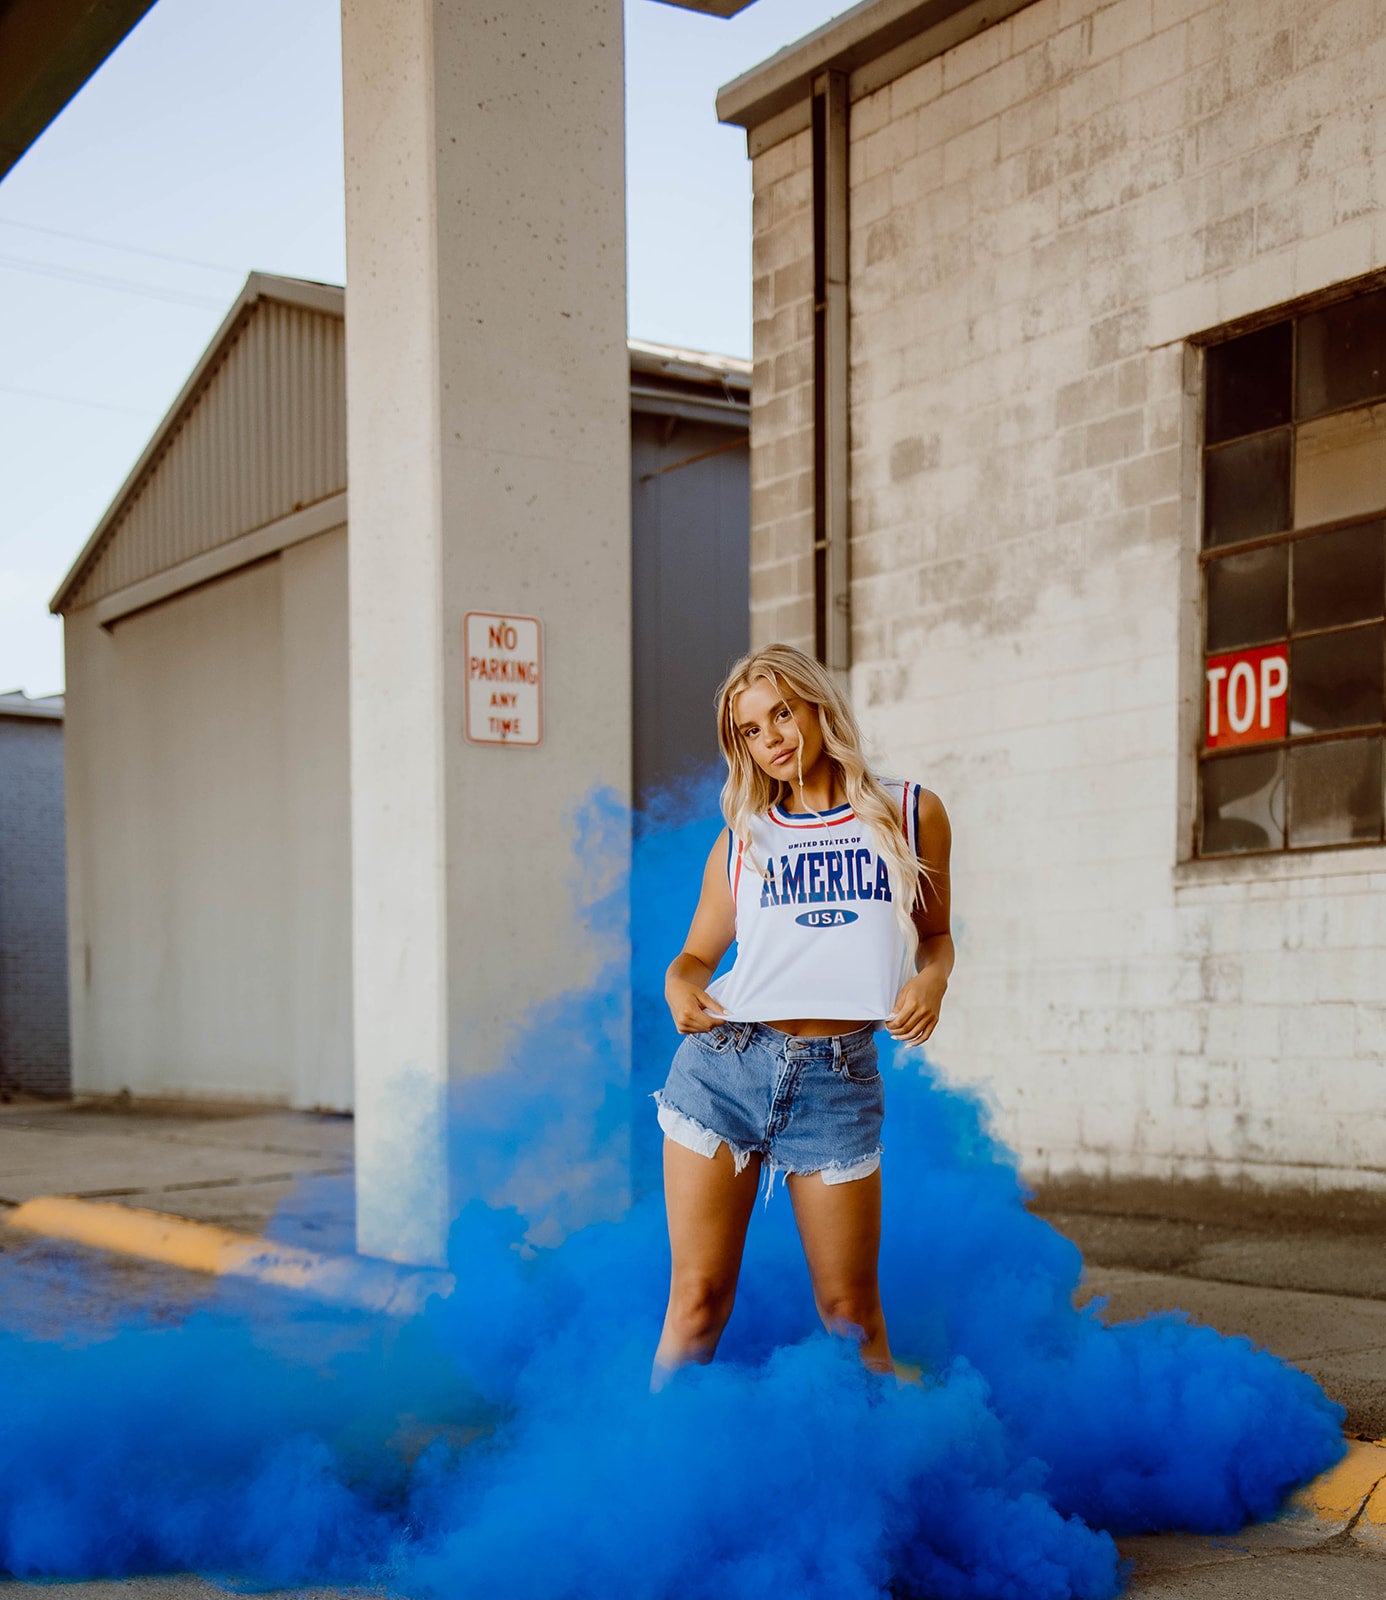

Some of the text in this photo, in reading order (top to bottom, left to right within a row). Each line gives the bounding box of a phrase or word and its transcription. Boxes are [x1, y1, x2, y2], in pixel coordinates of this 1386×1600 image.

[488, 625, 518, 650] NO
[470, 656, 538, 685] PARKING
[490, 692, 518, 708] ANY
[1207, 656, 1289, 737] TOP
[488, 716, 521, 735] TIME
[788, 836, 861, 850] UNITED STATES OF
[760, 848, 892, 908] AMERICA
[807, 913, 846, 925] USA
